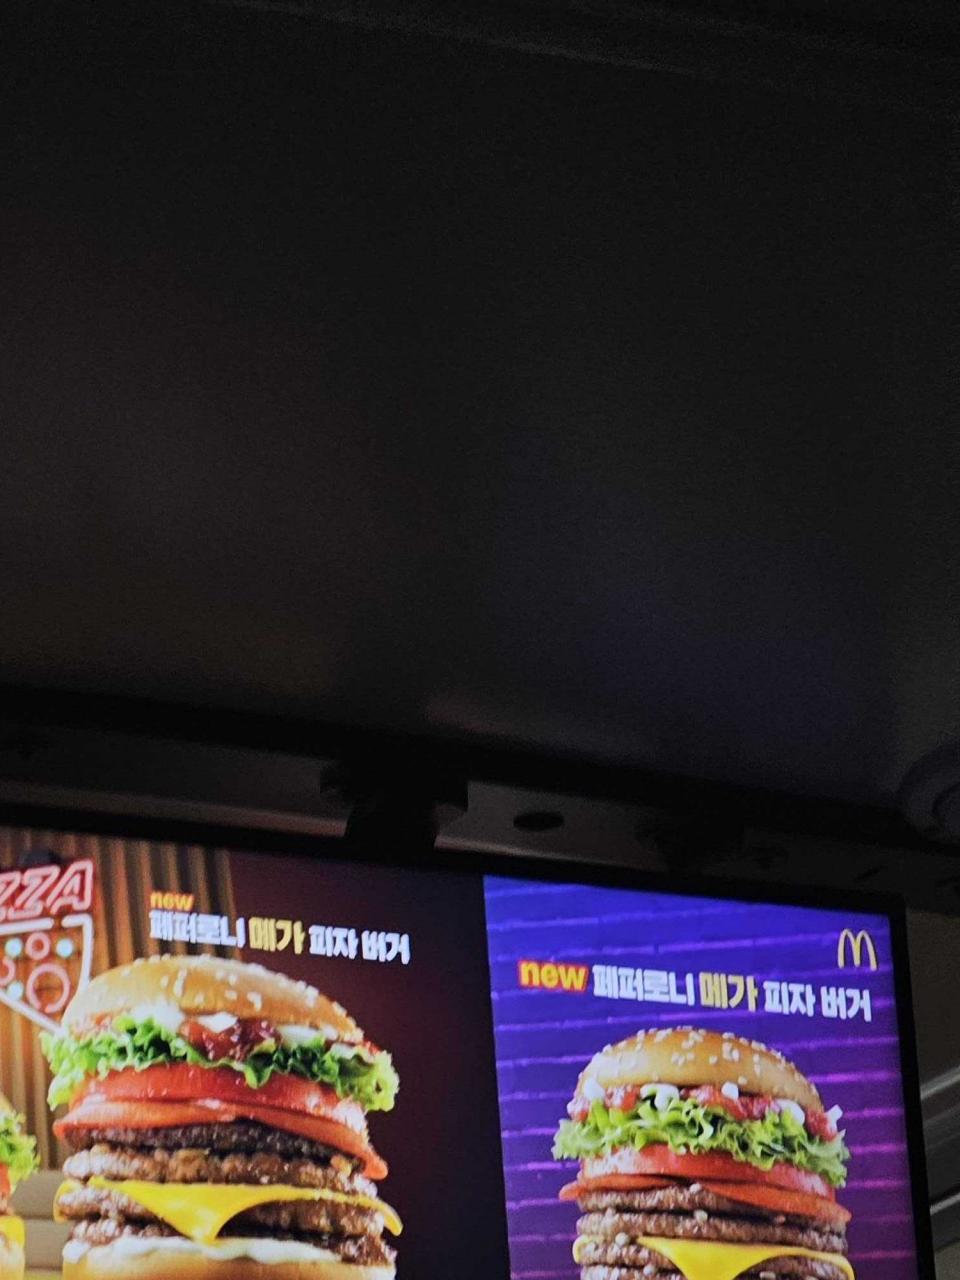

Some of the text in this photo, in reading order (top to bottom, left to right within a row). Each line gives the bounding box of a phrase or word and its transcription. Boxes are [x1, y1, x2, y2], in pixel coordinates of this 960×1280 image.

[150, 890, 194, 911] new
[149, 909, 411, 965] 페퍼로니 메가 피자 버거
[519, 959, 872, 1022] new 페퍼로니 메가 피자 버거
